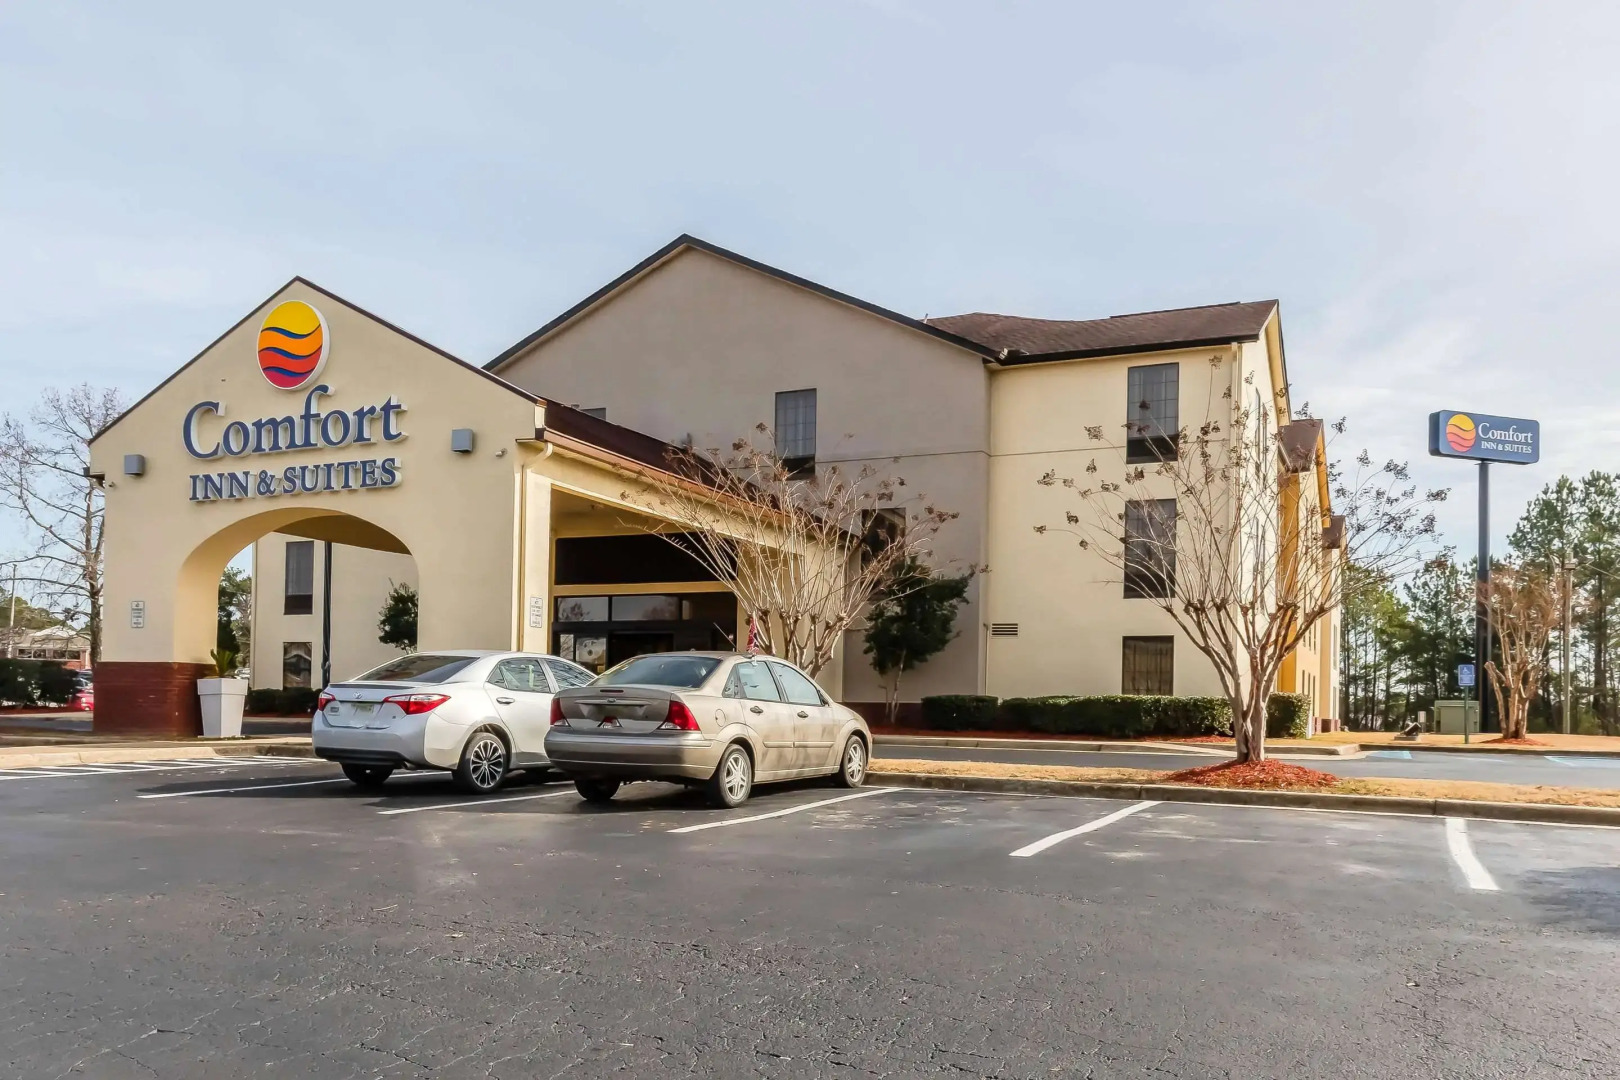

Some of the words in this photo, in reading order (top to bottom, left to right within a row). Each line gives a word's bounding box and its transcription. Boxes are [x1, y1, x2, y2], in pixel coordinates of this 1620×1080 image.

[182, 384, 408, 460] Comfort
[1478, 422, 1533, 443] Comfort
[1481, 441, 1497, 450] INN
[1504, 444, 1532, 454] SUITES
[188, 470, 255, 502] INN
[256, 469, 278, 496] &
[282, 458, 402, 495] SUITES
